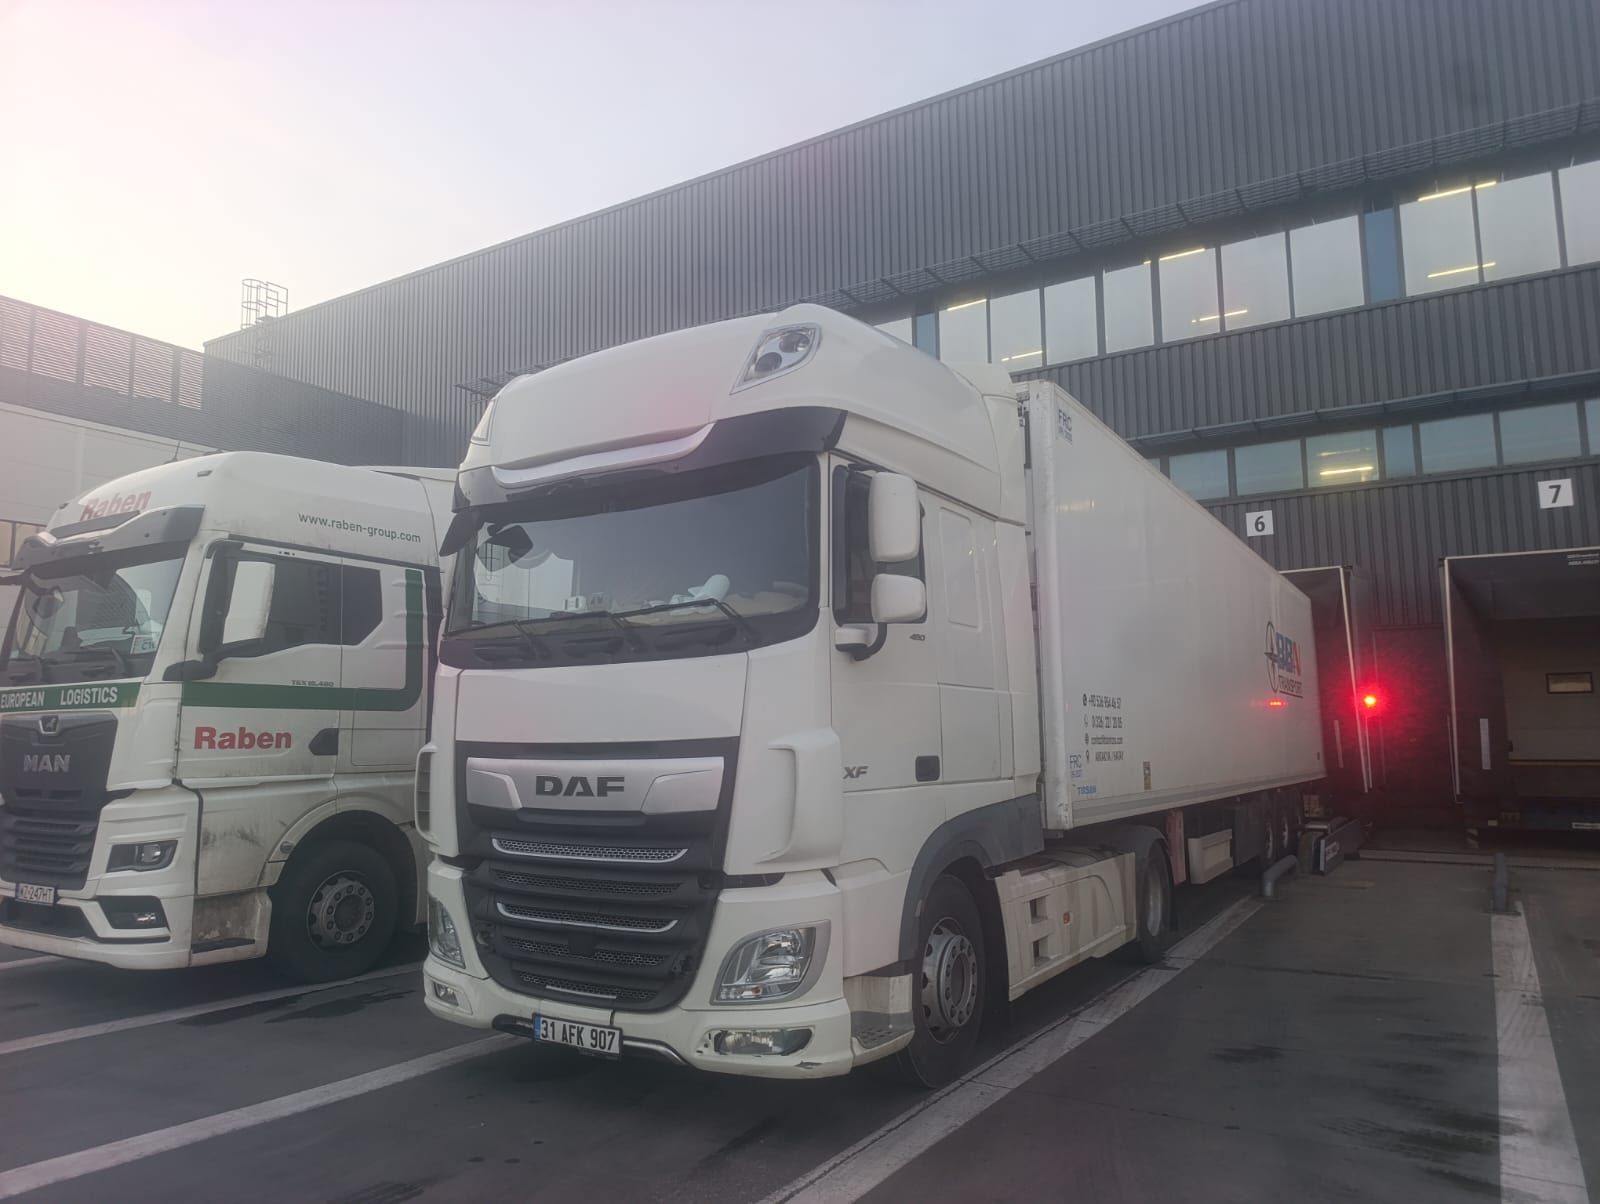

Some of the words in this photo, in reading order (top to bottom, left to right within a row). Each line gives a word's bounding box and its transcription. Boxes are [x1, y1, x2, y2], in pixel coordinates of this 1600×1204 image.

[1548, 485, 1562, 504] 7
[80, 491, 152, 521] Raben
[298, 513, 422, 543] www.raben-group.com
[1254, 516, 1266, 532] 6
[0, 691, 45, 708] EUROPEAN
[60, 687, 118, 705] LOGISTICS
[194, 726, 293, 750] Raben
[23, 754, 71, 773] MAN
[843, 766, 868, 780] XF
[535, 775, 625, 797] DAF
[541, 1019, 556, 1040] 31
[562, 1023, 584, 1046] AFK
[590, 1028, 616, 1051] 907
